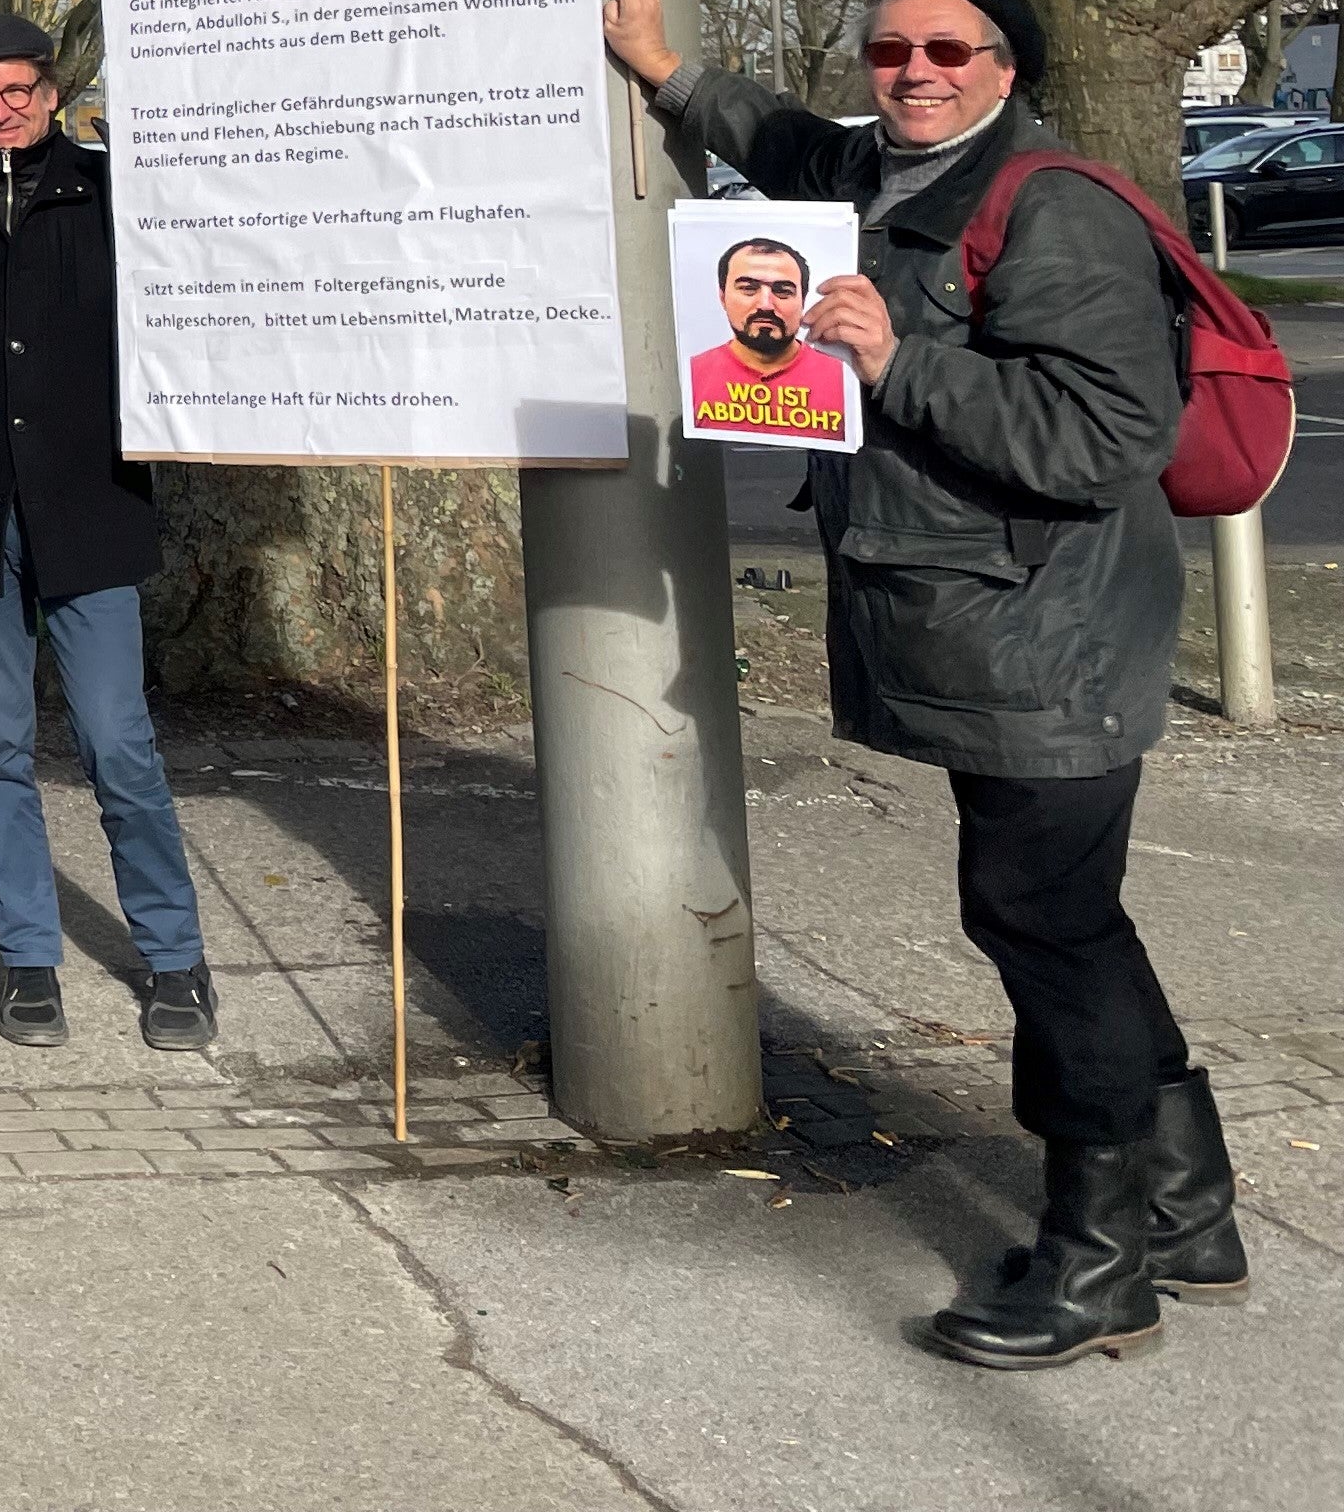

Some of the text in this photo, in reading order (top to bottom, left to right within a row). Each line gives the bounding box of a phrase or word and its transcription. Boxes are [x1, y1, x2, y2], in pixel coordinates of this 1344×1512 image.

[130, 20, 193, 36] Kindern,
[196, 11, 268, 31] Abdullohi
[271, 10, 291, 26] S.,
[294, 8, 309, 23] in
[313, 6, 340, 21] der
[344, 0, 458, 22] gemeinsamen
[130, 23, 446, 59] Unionviertel nachts aus dem Bett geholt.
[131, 83, 584, 120] Trotz eindringlicher Gefährdungswarnungen, trotz allem
[132, 109, 581, 145] Bitten und Flehen, Abschiebung nach Tadschikistan und
[134, 147, 350, 169] Auslieferung an das Regime.
[137, 205, 531, 231] Wie erwartet sofortige Verhaftung am Flughafen.
[143, 273, 506, 296] sitzt seitdem in einem Foltergefängnis, wurde
[146, 305, 611, 331] kahlgeschoren, bittet um Lebensmittel, Matratze, Decke..
[146, 391, 459, 408] Jahrzehntelange Haft für Nichts drohen.
[726, 381, 811, 407] WO IST
[696, 400, 843, 432] ABDULLOH?
